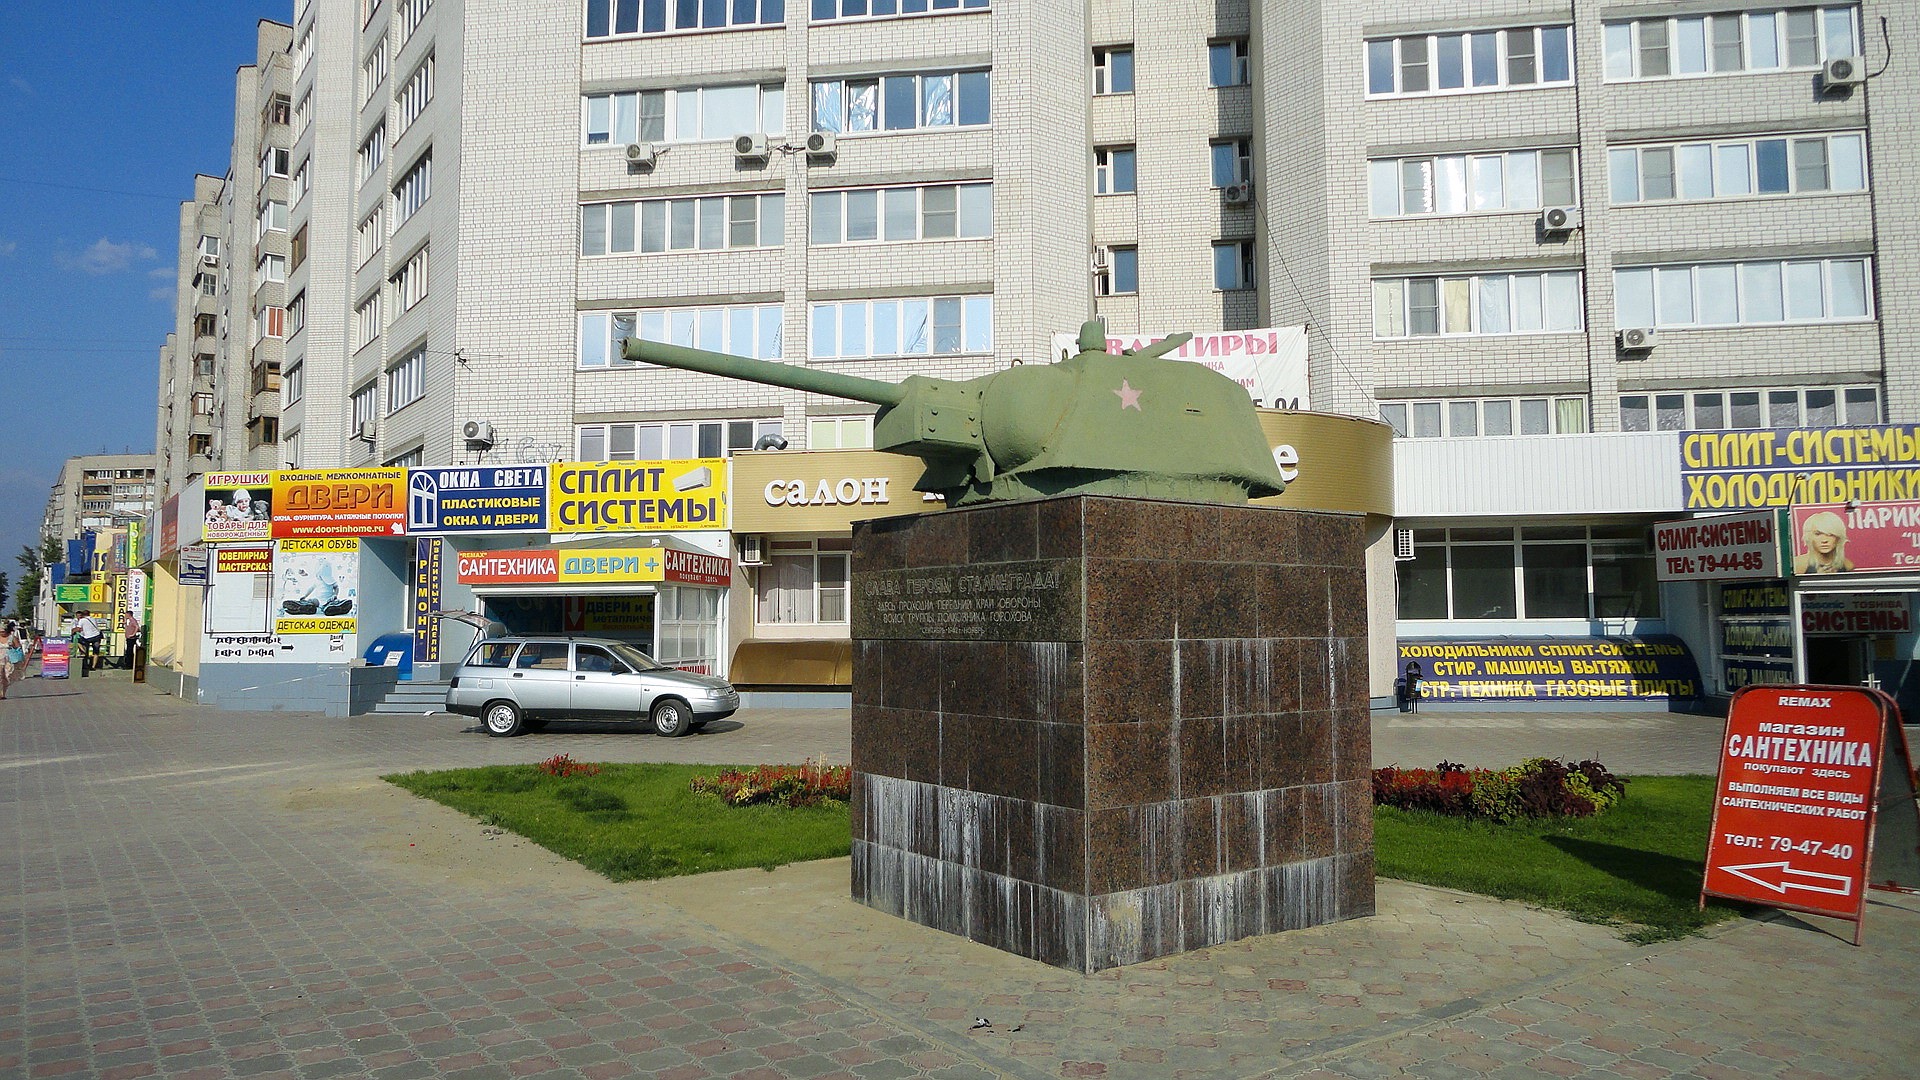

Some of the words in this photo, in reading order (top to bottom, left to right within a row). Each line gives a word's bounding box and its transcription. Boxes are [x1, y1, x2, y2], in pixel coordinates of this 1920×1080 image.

[1684, 428, 1920, 468] СПЛИТ-СИСТЕМЫ
[208, 474, 269, 486] ИГРУШКИ
[326, 471, 401, 480] МЕЖКОМНАТНЫЕ
[439, 470, 480, 487] ОКНА
[494, 469, 543, 486] СВЕТА
[560, 468, 665, 494] СПЛИТ
[286, 483, 394, 511] ДВЕРИ
[764, 477, 889, 505] салон
[441, 498, 541, 509] ПЛАСТИКОВЫЕ
[559, 498, 716, 525] СИСТЕМЫ
[207, 521, 244, 530] ТОВАРЫ
[247, 521, 267, 530] ДЛЯ
[334, 512, 371, 521] НАТЯЖНЫЕ
[372, 512, 404, 520] ПОТОЛКИ
[443, 514, 473, 526] ОКНА
[482, 514, 492, 524] И
[494, 513, 539, 525] ДВЕРИ
[206, 531, 267, 539] НОВОРОЖДЕННЫХ
[292, 524, 385, 534] www.doorsinhome.ru
[1657, 519, 1772, 551] СПЛИТ-СИСТЕМЫ
[281, 540, 324, 550] ДЕТСКАЯ
[327, 539, 357, 550] ОБУВЬ
[431, 540, 441, 603] ЮВЕЛИРНЫХ
[458, 557, 556, 577] САНТЕХНИКА
[564, 556, 639, 574] ДВЕРИ
[665, 550, 730, 577] САНТЕХНИКА
[1666, 556, 1694, 574] ТЕЛ:
[1699, 551, 1763, 573] 79-44-85
[865, 580, 900, 596] СЛАВА
[906, 577, 951, 595] ГЕРОЯМ
[959, 571, 1060, 593] СТАЛИНГРАДА!
[117, 579, 127, 629] ЛОМБАРД
[418, 560, 427, 639] РЕМОНТ
[586, 602, 630, 615] ДВЕРИ
[1000, 597, 1041, 609] ОБОРОНЫ
[1852, 600, 1903, 609] TOSHIBA
[277, 621, 315, 631] ДЕТСКАЯ
[318, 620, 355, 630] ОДЕЖДА
[989, 611, 1032, 622] ГОРОХОВА
[1802, 610, 1909, 631] СИСТЕМЫ
[430, 610, 439, 660] ЗДЕЛИЙ
[1400, 645, 1534, 659] ХОЛОДИЛЬНИКИ
[1539, 643, 1685, 657] СПЛИТ-СИСТЕМЫ
[1434, 661, 1482, 676] СТИР.
[1486, 661, 1565, 675] МАШИНЫ
[1572, 660, 1659, 675] ВЫТЯЖКИ
[1458, 680, 1536, 698] ТЕХНИКА
[1547, 679, 1628, 698] ГАЗОВЫЕ
[1631, 678, 1695, 697] ПЛИТЫ
[1778, 697, 1832, 708] REMAX
[1758, 722, 1845, 737] магазин
[1728, 734, 1872, 767] САНТЕХНИКА
[1743, 761, 1805, 775] покупают
[1811, 766, 1851, 779] здесь
[1728, 781, 1800, 798] ВЫПОЛНЯЕМ
[1801, 789, 1825, 801] ВСЕ
[1827, 791, 1863, 804] ВИДЫ
[1722, 796, 1825, 816] САНТЕХНИЧЕСКИХ
[1826, 807, 1867, 821] РАБОТ
[1724, 833, 1764, 848] тел:
[1769, 835, 1853, 860] 79-47-40
